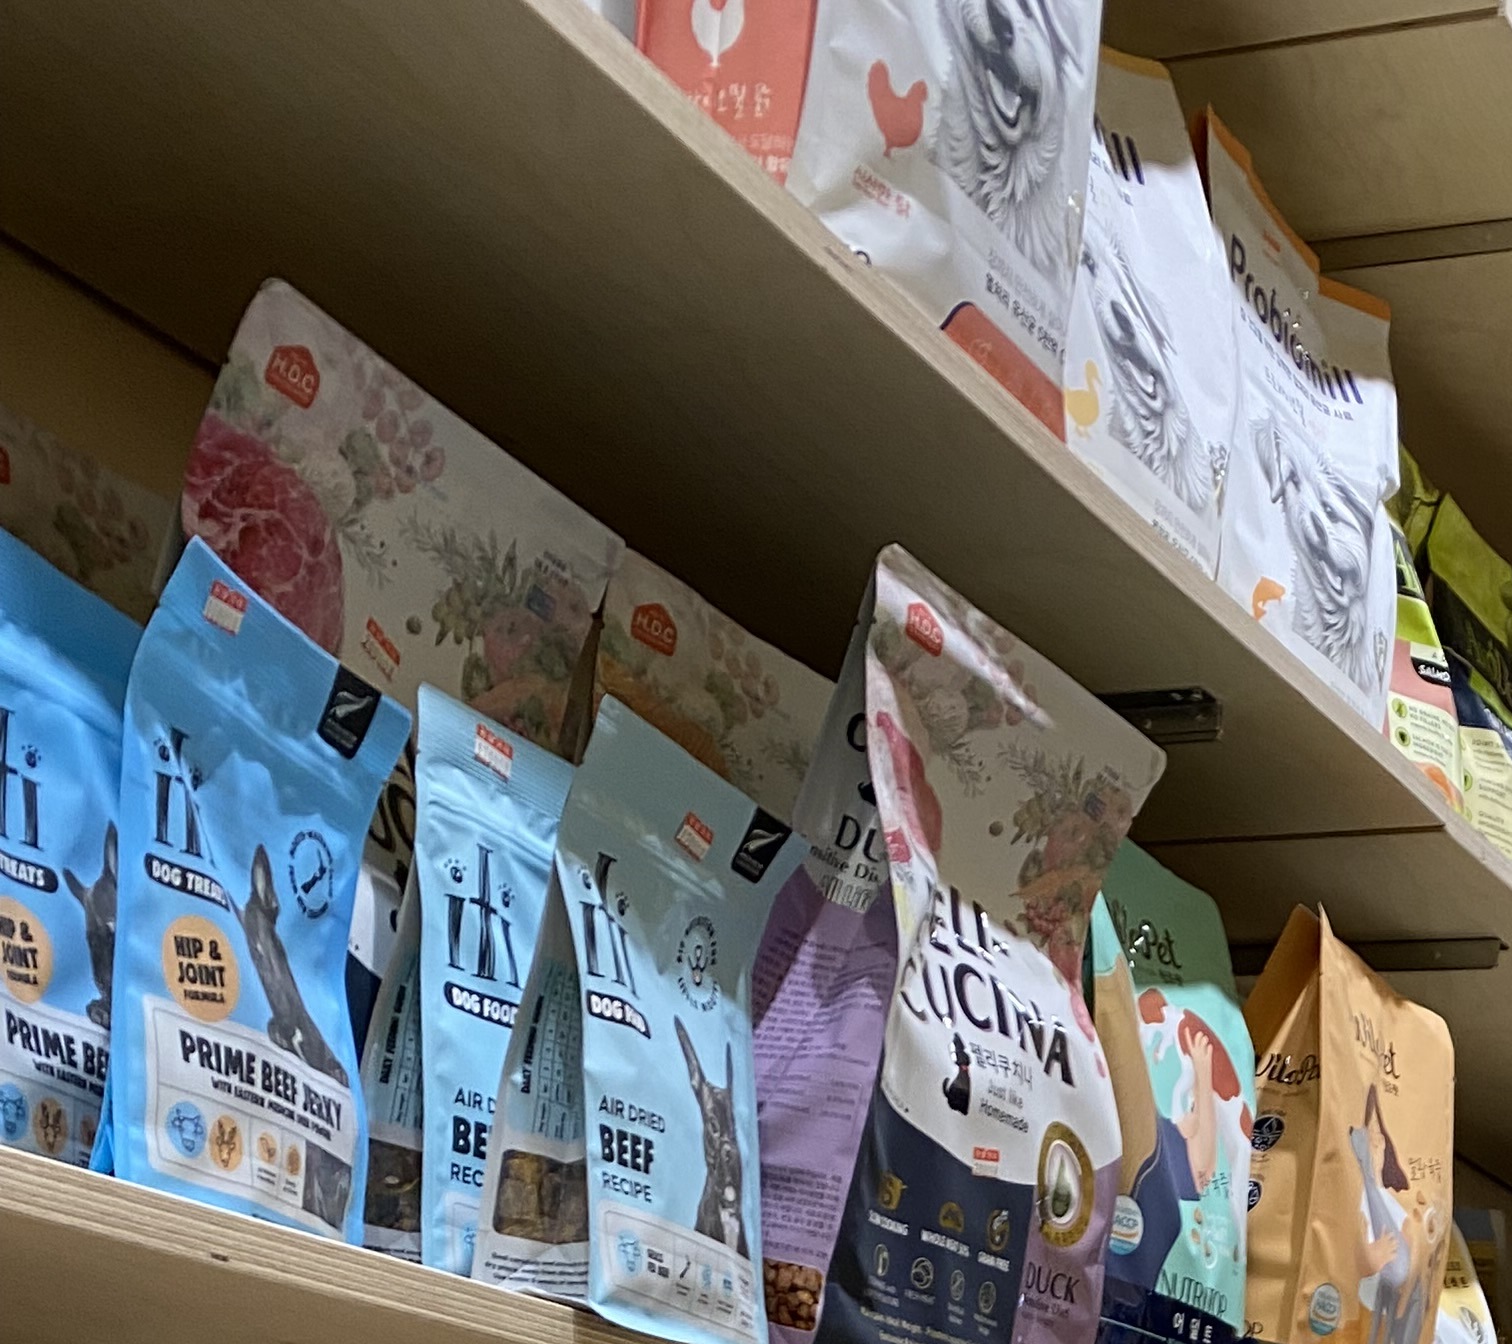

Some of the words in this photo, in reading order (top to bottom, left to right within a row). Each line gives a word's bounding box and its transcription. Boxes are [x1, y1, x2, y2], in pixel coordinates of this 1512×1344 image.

[151, 860, 181, 886] DOG
[174, 935, 202, 958] HIP
[209, 940, 222, 960] &
[178, 961, 226, 988] JOINT
[451, 987, 480, 1014] DOG
[591, 993, 622, 1017] DOG
[6, 1009, 76, 1067] PRIME
[901, 961, 1077, 1088] CUCINA
[179, 1030, 255, 1086] PRIME
[261, 1062, 298, 1105] BEEF
[302, 1083, 343, 1132] JERKY
[454, 1088, 482, 1111] AIR
[599, 1095, 625, 1120] AIR
[628, 1104, 666, 1134] DRIED
[979, 1097, 1030, 1135] Homemade
[452, 1115, 490, 1159] BE
[598, 1123, 655, 1175] BEEF
[601, 1171, 653, 1205] RECIPE
[1026, 1260, 1080, 1304] DUCK
